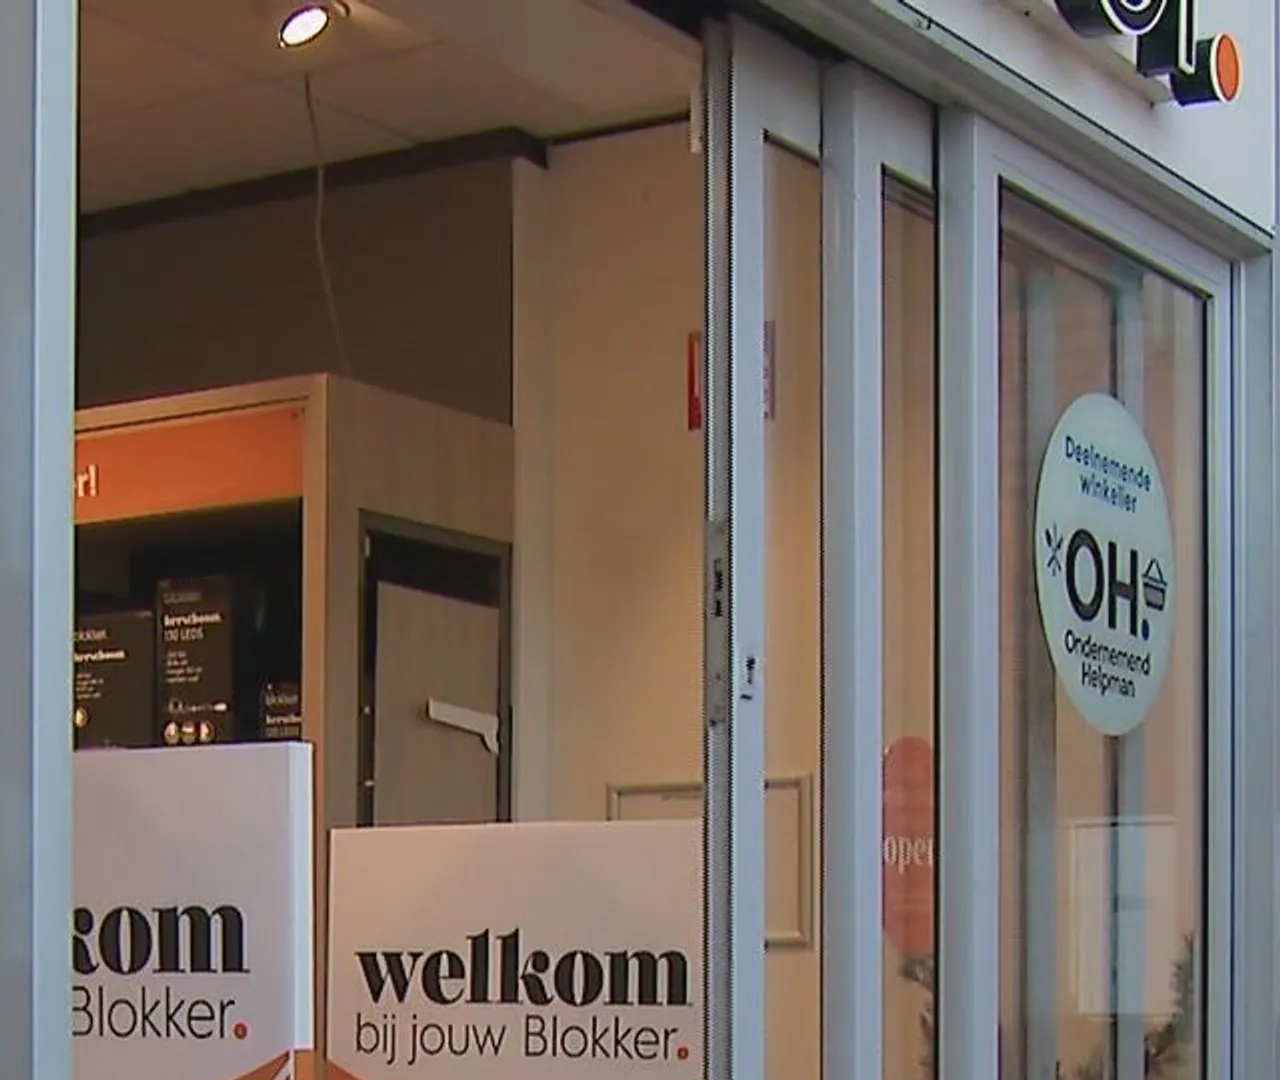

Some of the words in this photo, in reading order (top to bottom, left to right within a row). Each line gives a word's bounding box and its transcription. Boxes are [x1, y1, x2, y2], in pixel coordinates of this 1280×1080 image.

[1064, 435, 1152, 492] Deelnemende
[1079, 472, 1138, 514] winkelier
[1064, 628, 1152, 677] Ondernemend
[1080, 660, 1136, 698] Helpman
[355, 929, 692, 1008] welkom
[73, 985, 248, 1040] Blokker.
[354, 1012, 398, 1063] bij
[407, 1016, 507, 1066] jouw
[524, 1014, 691, 1061] Blokker.
